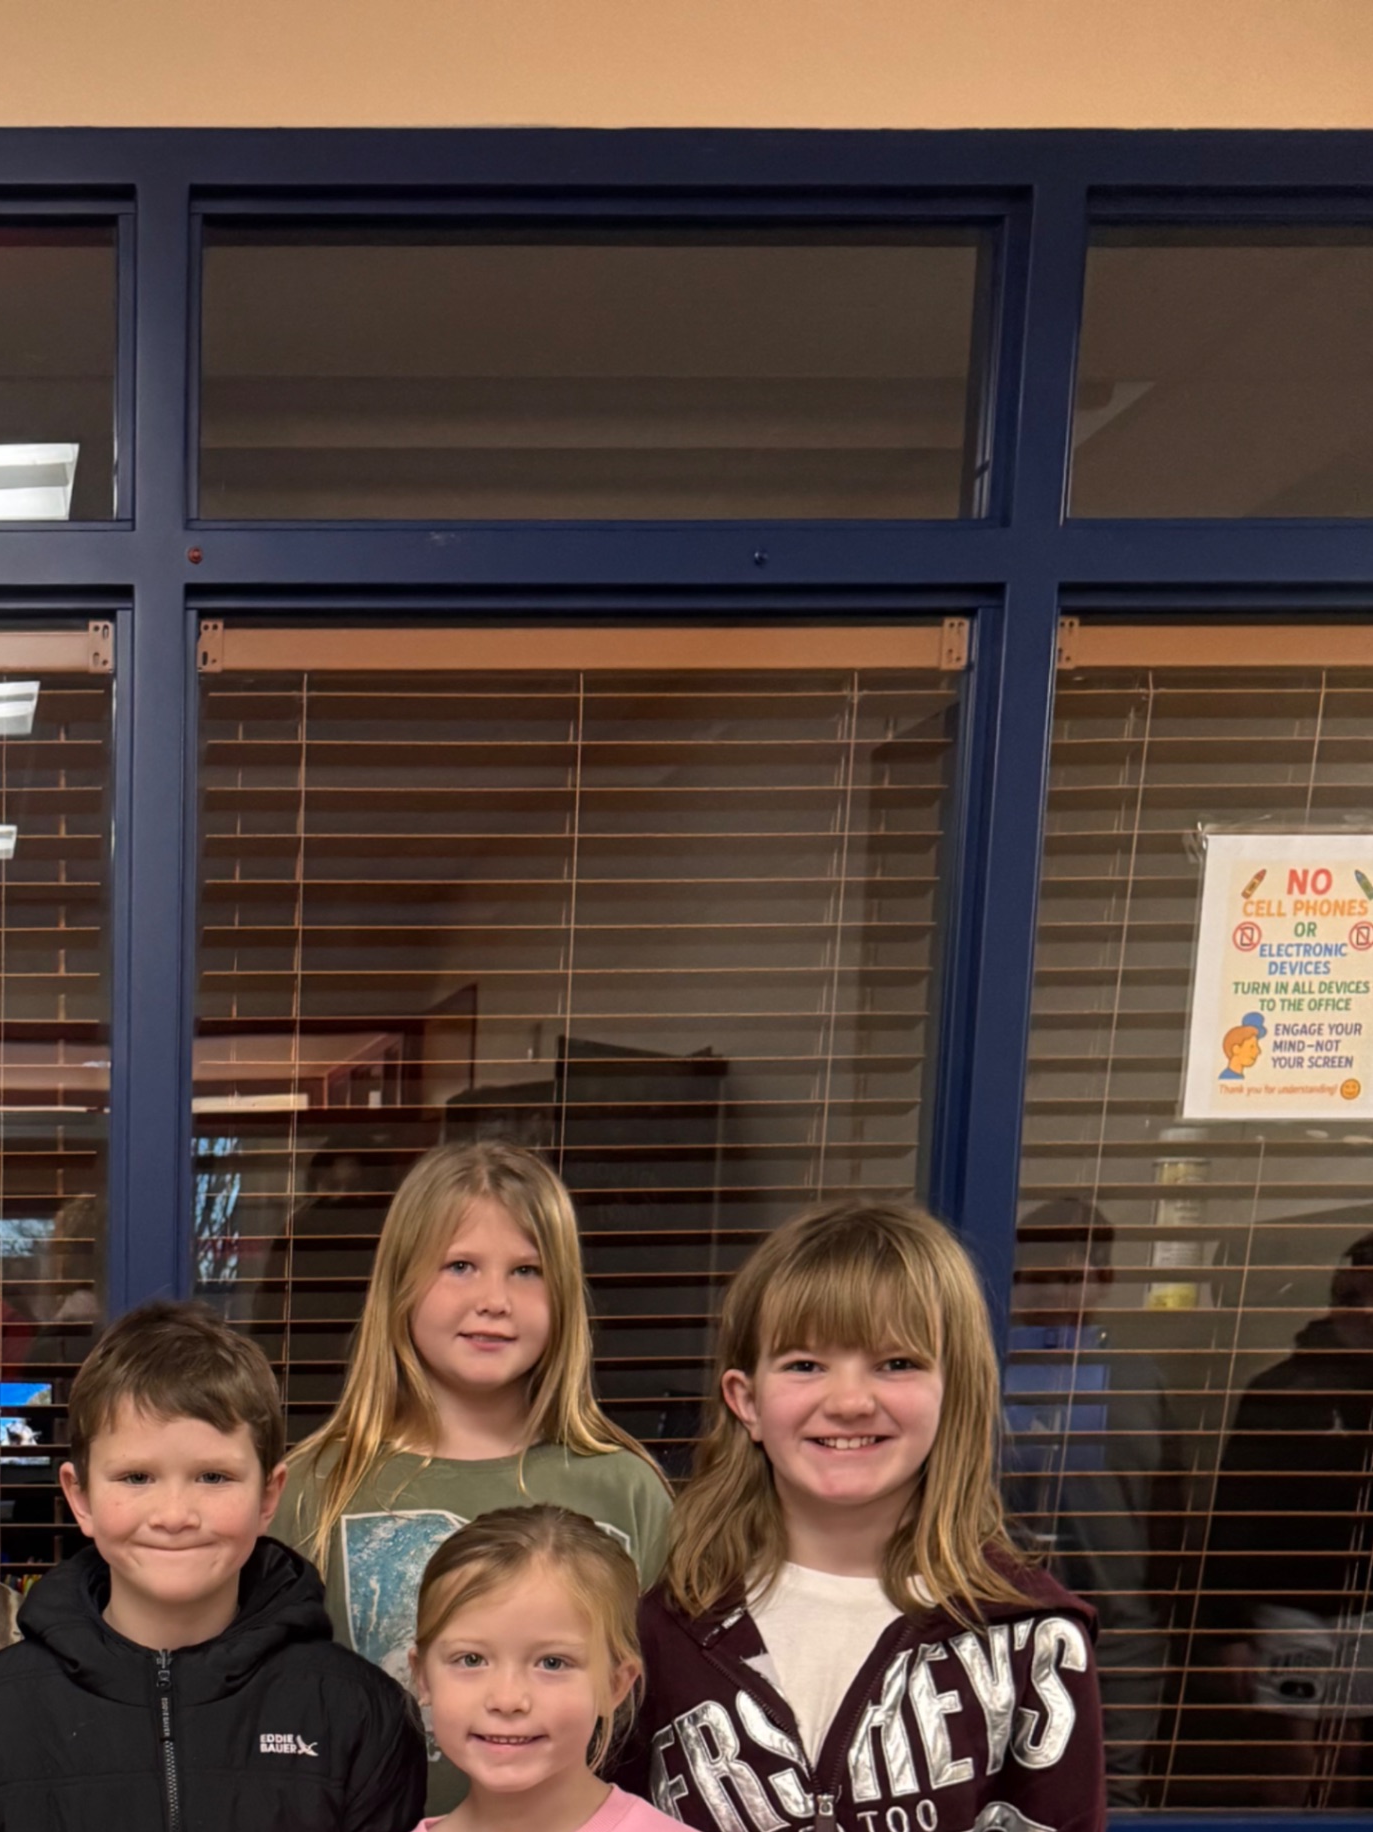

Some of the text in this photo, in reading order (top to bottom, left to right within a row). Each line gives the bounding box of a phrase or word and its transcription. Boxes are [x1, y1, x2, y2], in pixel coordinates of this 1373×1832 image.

[1287, 868, 1333, 896] NO
[1242, 899, 1369, 917] CELL PHONES
[1294, 921, 1317, 937] OR
[1259, 943, 1348, 958] ELECTRONIC
[1268, 960, 1331, 975] DEVICES
[1233, 980, 1370, 995] TURN IN ALL DEVICES
[1259, 998, 1352, 1012] TO THE OFFICE
[1273, 1023, 1363, 1036] ENGAGE YOUR
[1271, 1056, 1354, 1069] YOUR SCREEN
[1219, 1084, 1244, 1095] Thank
[1246, 1085, 1262, 1097] you
[259, 1733, 294, 1743] EDDIE
